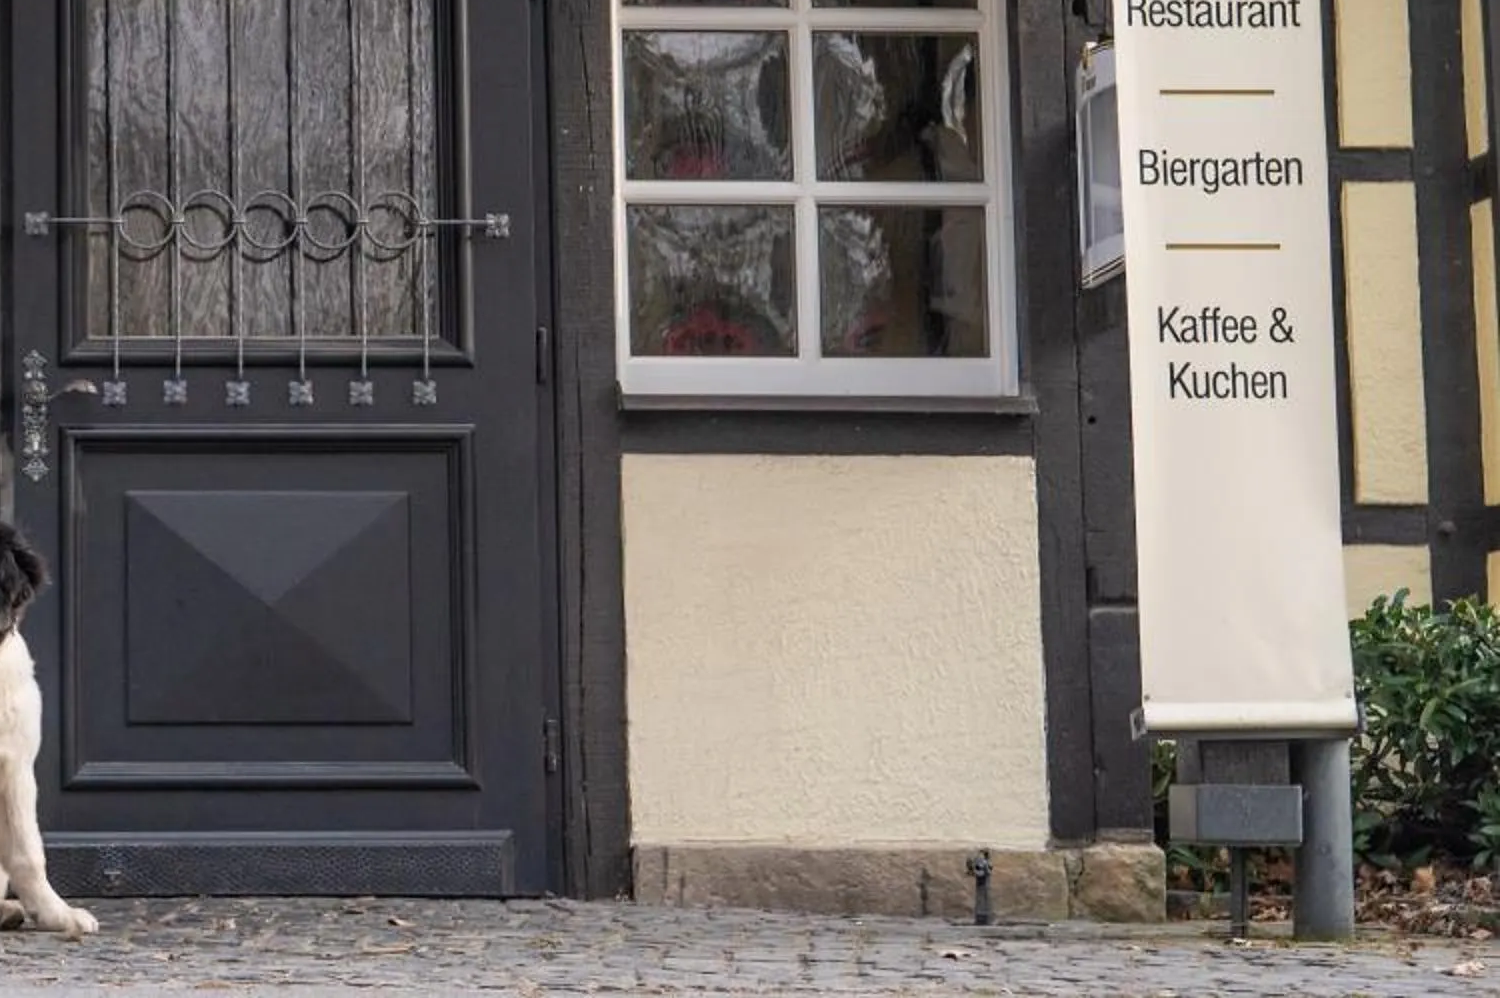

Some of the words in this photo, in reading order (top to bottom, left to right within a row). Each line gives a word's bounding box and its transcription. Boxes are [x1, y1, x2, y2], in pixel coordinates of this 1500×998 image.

[1138, 149, 1304, 194] Biergarten
[1157, 306, 1258, 344] Kaffee
[1269, 307, 1295, 343] &
[1169, 362, 1288, 400] Kuchen
